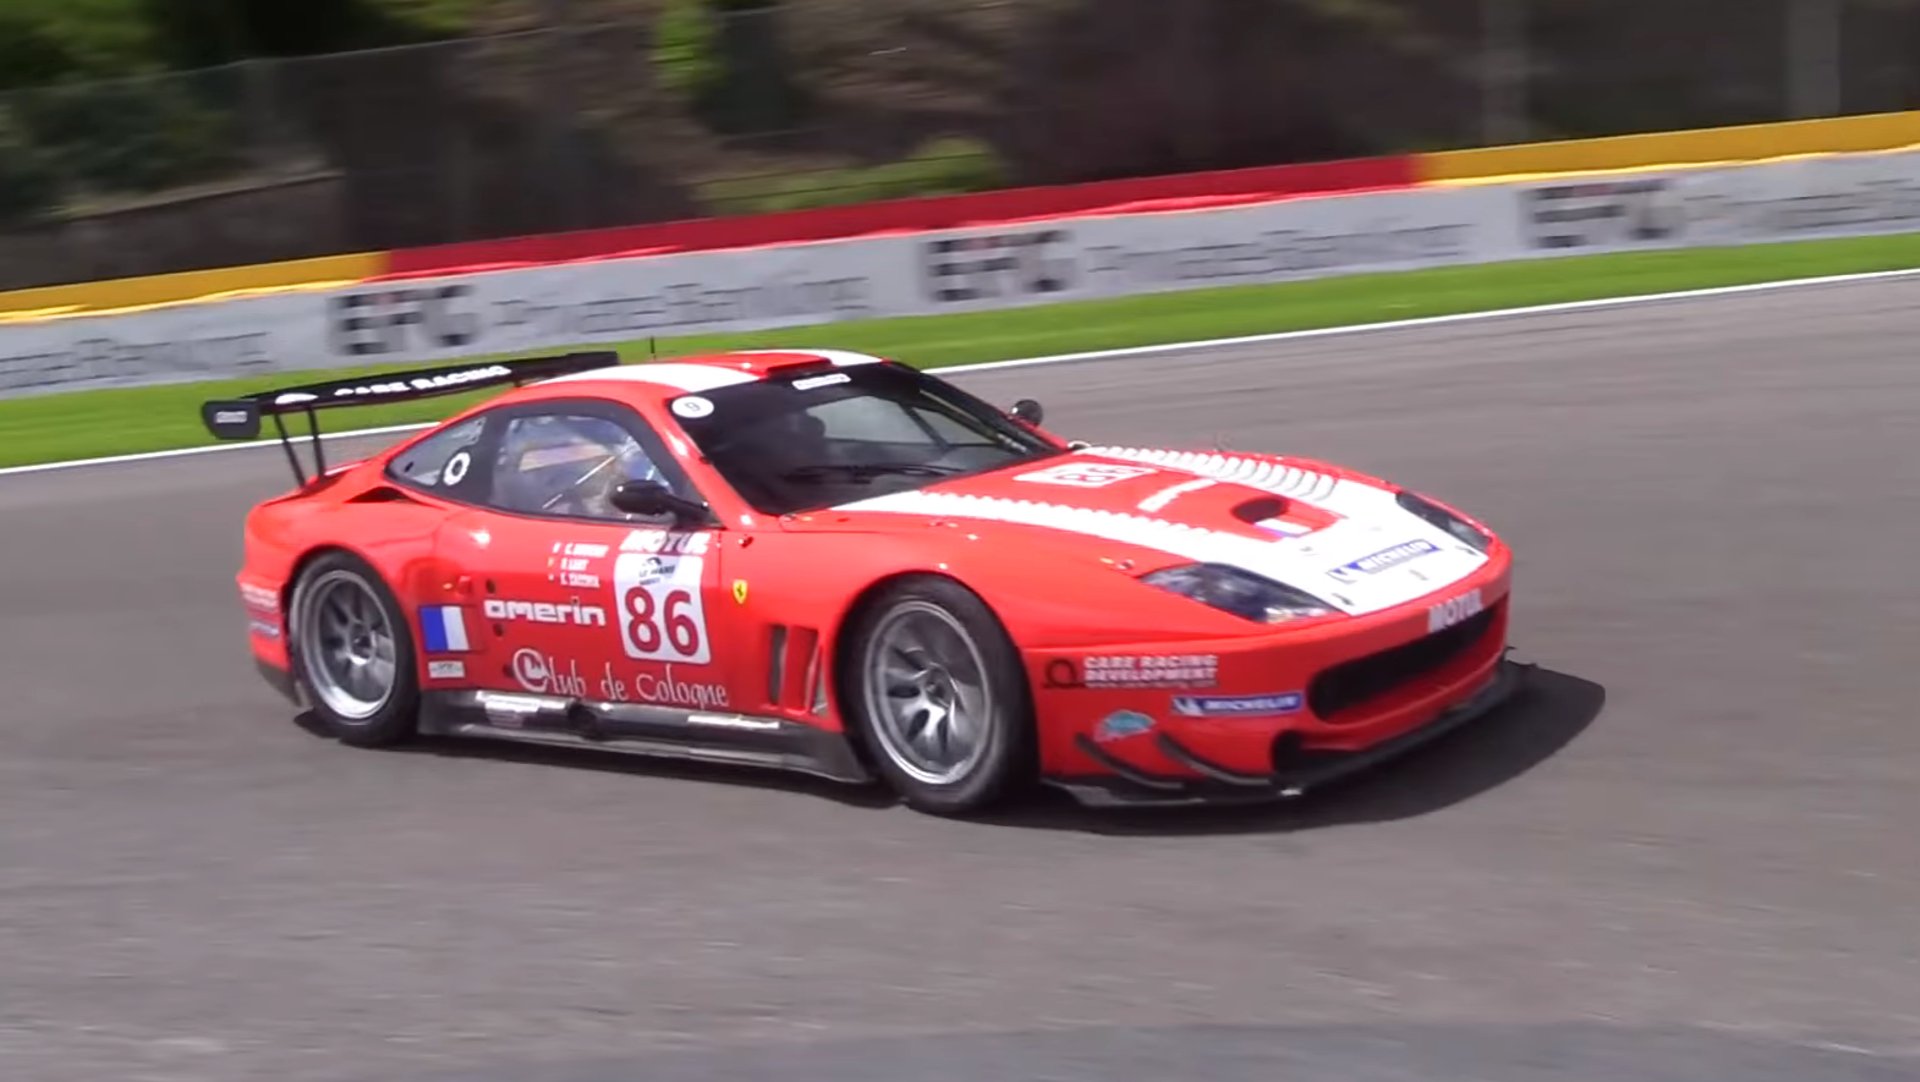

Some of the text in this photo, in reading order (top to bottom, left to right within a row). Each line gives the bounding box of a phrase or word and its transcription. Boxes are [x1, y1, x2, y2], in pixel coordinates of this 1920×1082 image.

[410, 365, 512, 389] RACING
[619, 530, 711, 555] MOTUL
[624, 586, 699, 657] 86
[1428, 587, 1484, 633] MOTUL
[1083, 655, 1219, 670] CARE RACING
[512, 648, 730, 709] Club de Cologne
[1084, 668, 1219, 682] DEVELOPMENT
[1202, 695, 1299, 711] MICHELIN
